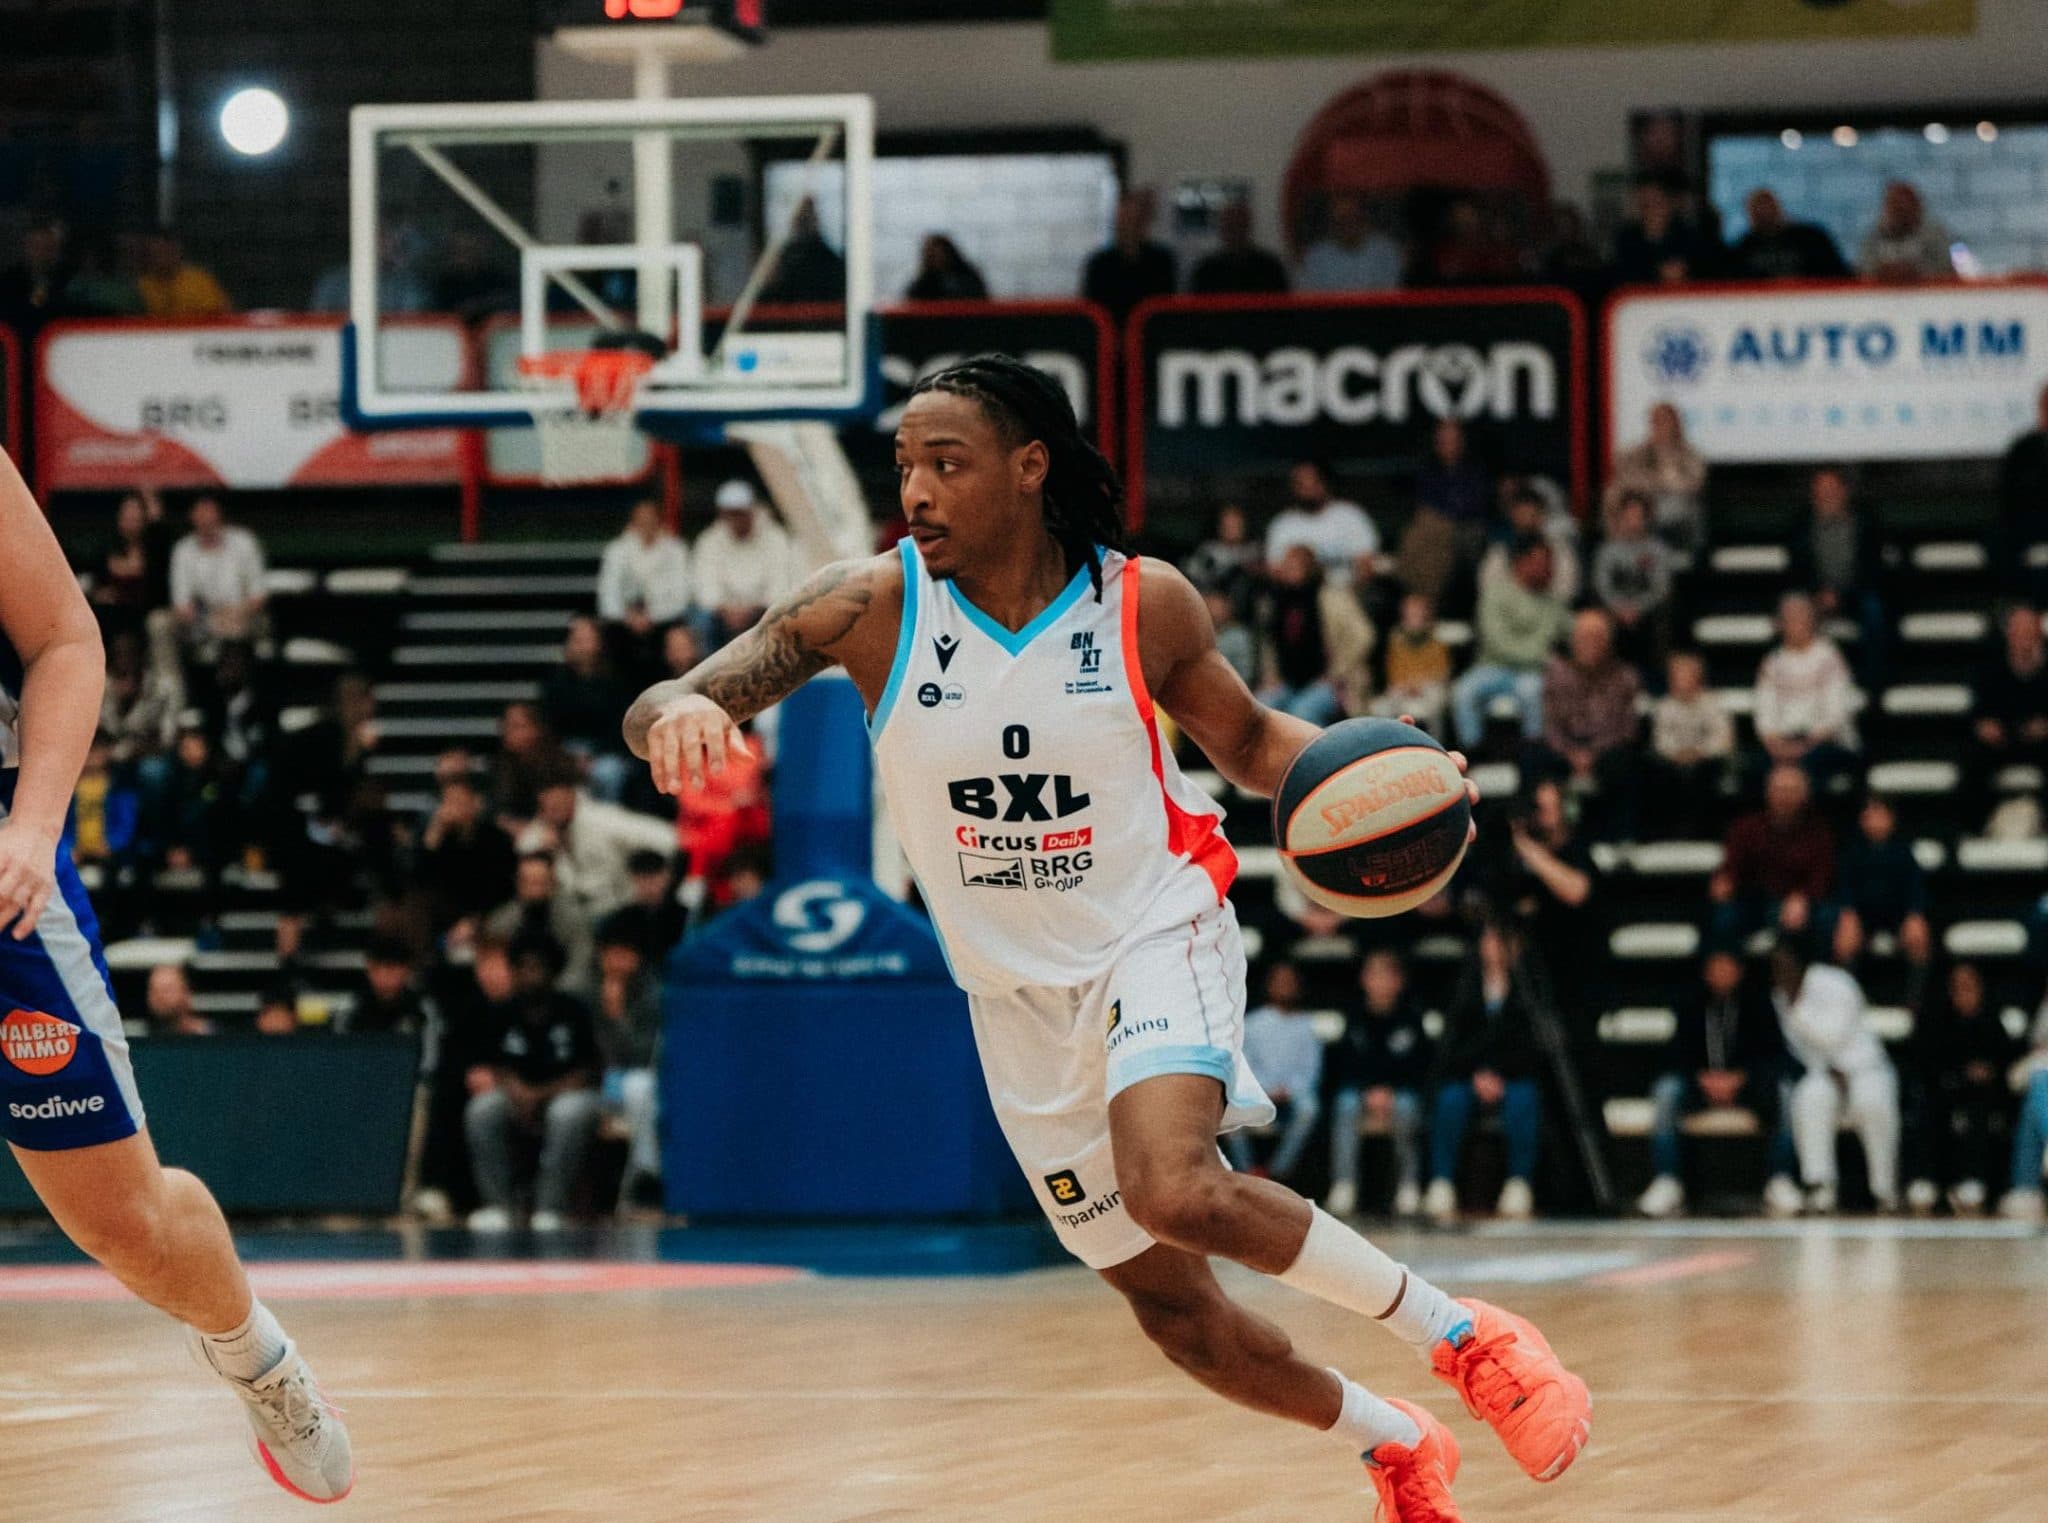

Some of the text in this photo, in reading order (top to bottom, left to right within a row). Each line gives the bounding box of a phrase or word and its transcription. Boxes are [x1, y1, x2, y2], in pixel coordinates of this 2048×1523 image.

[1730, 321, 2025, 366] AUTO MM
[1157, 342, 1557, 428] macron
[287, 395, 341, 425] BR
[1002, 724, 1031, 760] 0
[947, 773, 1092, 822] BXL
[1321, 765, 1448, 837] SPALDING
[956, 826, 1088, 851] Circus Daily
[1031, 851, 1094, 878] BRG
[8, 1038, 71, 1060] IMMO
[9, 1095, 105, 1119] sodiwe
